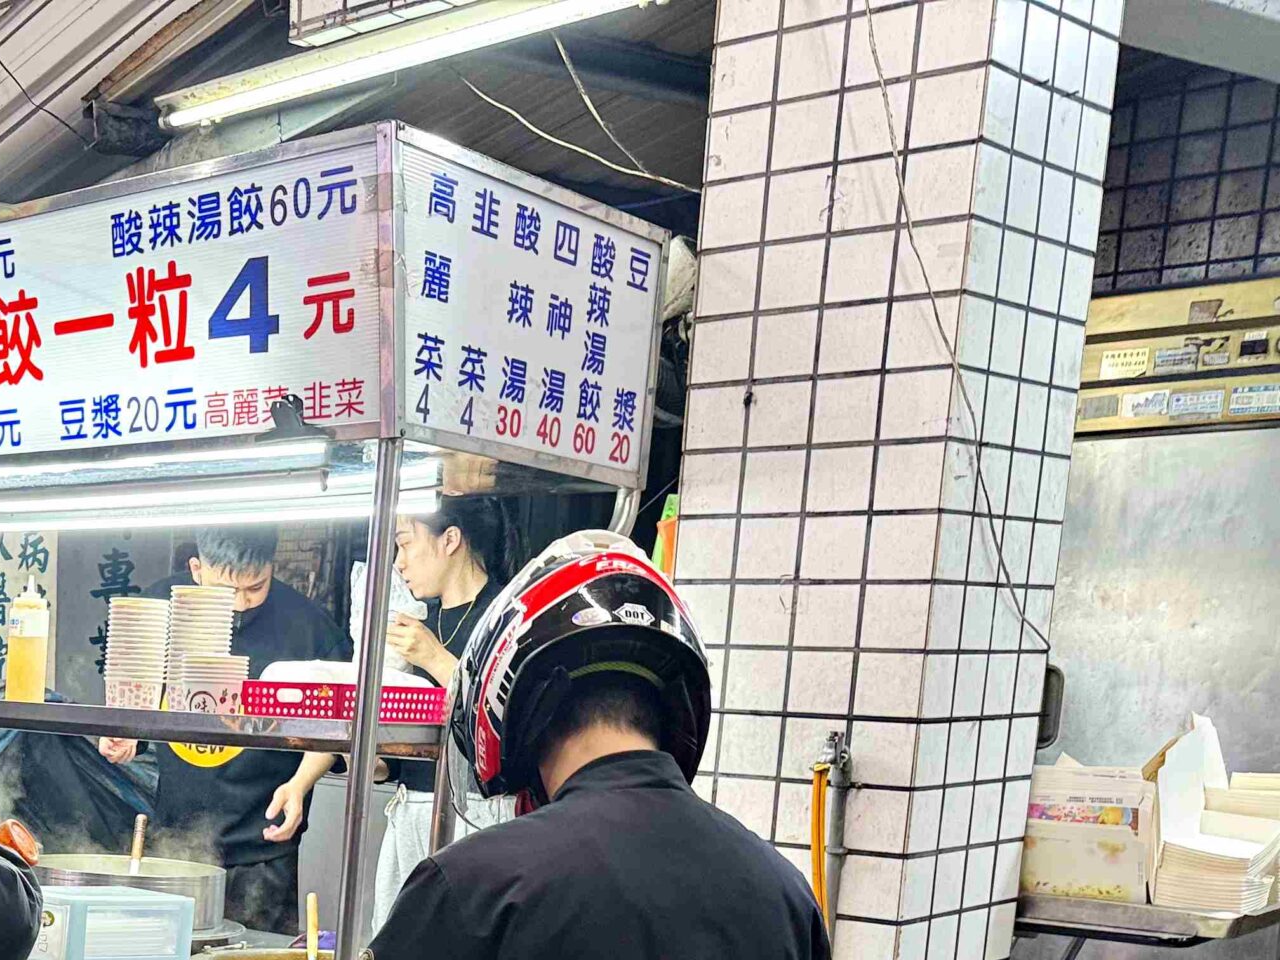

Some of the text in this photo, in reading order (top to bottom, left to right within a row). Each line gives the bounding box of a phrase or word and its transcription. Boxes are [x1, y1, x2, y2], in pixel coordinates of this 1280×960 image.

[110, 164, 358, 258] 酸辣湯餃60元
[58, 388, 198, 442] 豆漿20元
[624, 609, 645, 621] DOT
